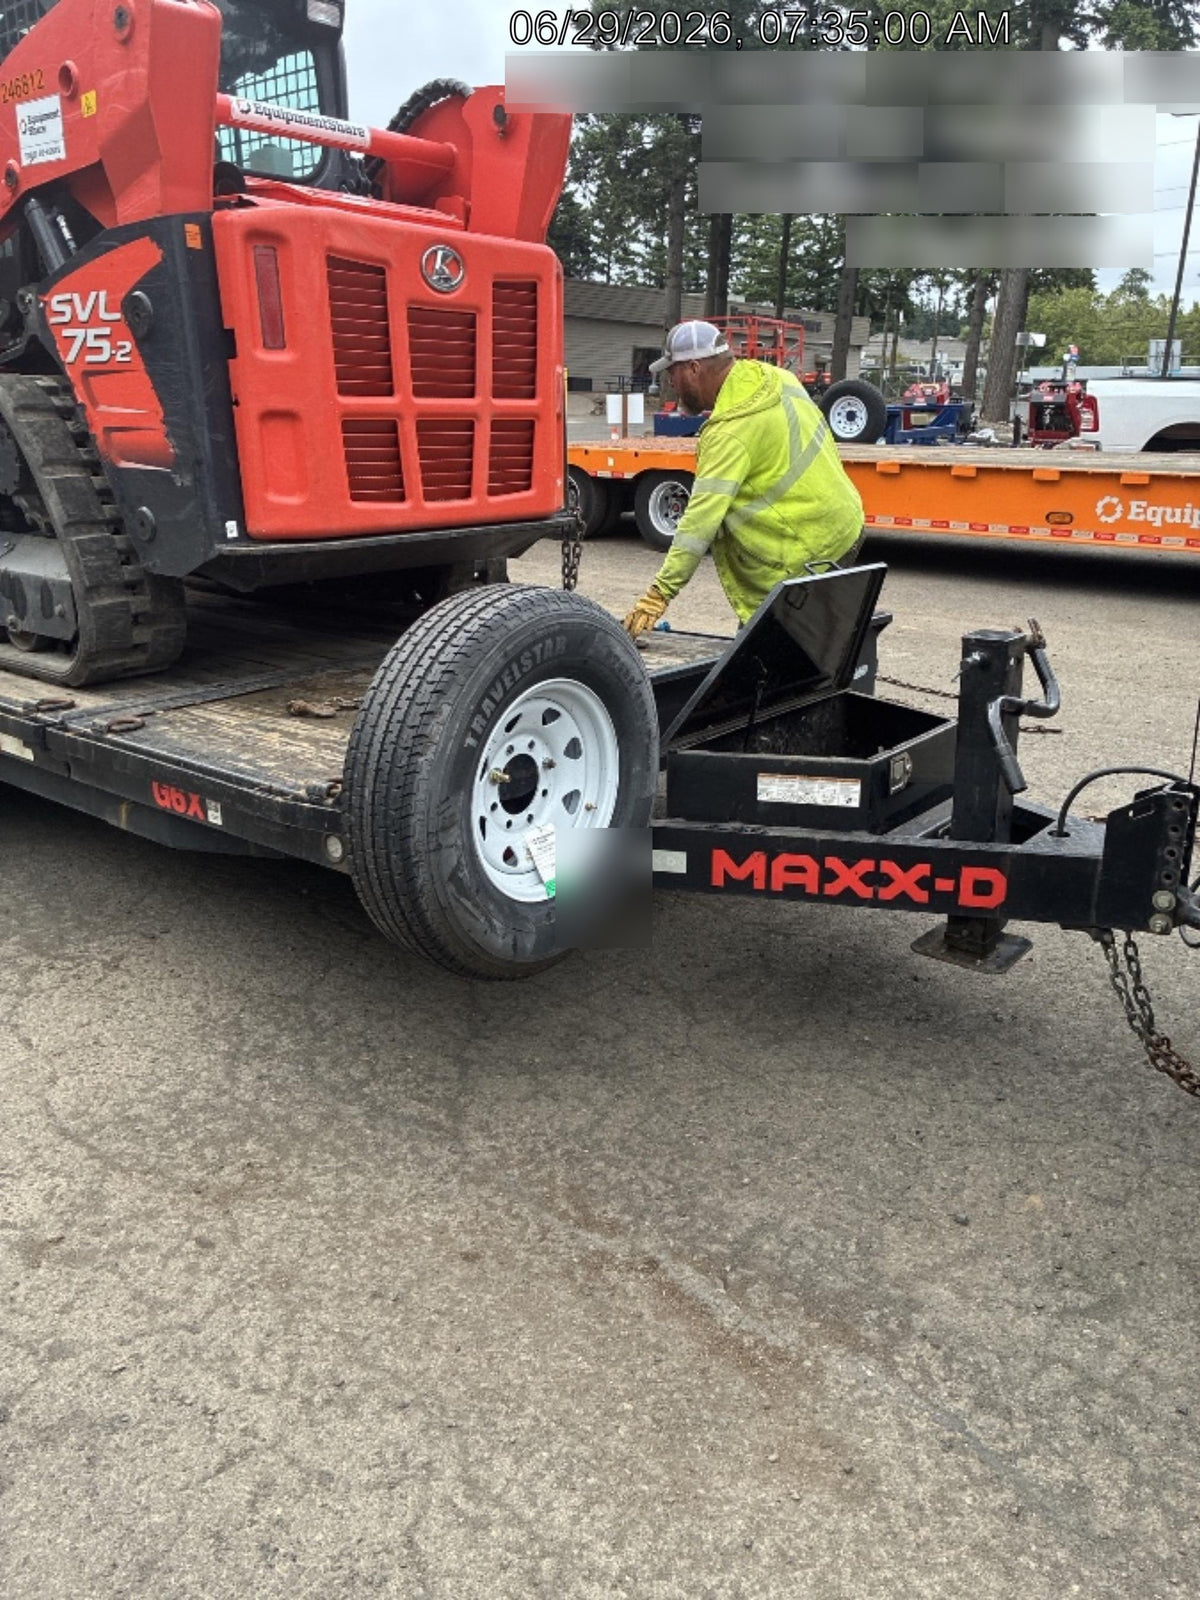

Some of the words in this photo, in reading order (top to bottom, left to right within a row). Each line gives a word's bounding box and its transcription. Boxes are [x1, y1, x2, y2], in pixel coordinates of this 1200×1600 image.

[254, 102, 365, 138] EquipmentShare
[49, 290, 122, 324] SVL
[61, 326, 132, 364] 75-2
[464, 634, 568, 748] TRAVELSTAR
[710, 849, 1007, 909] MAXX-D
